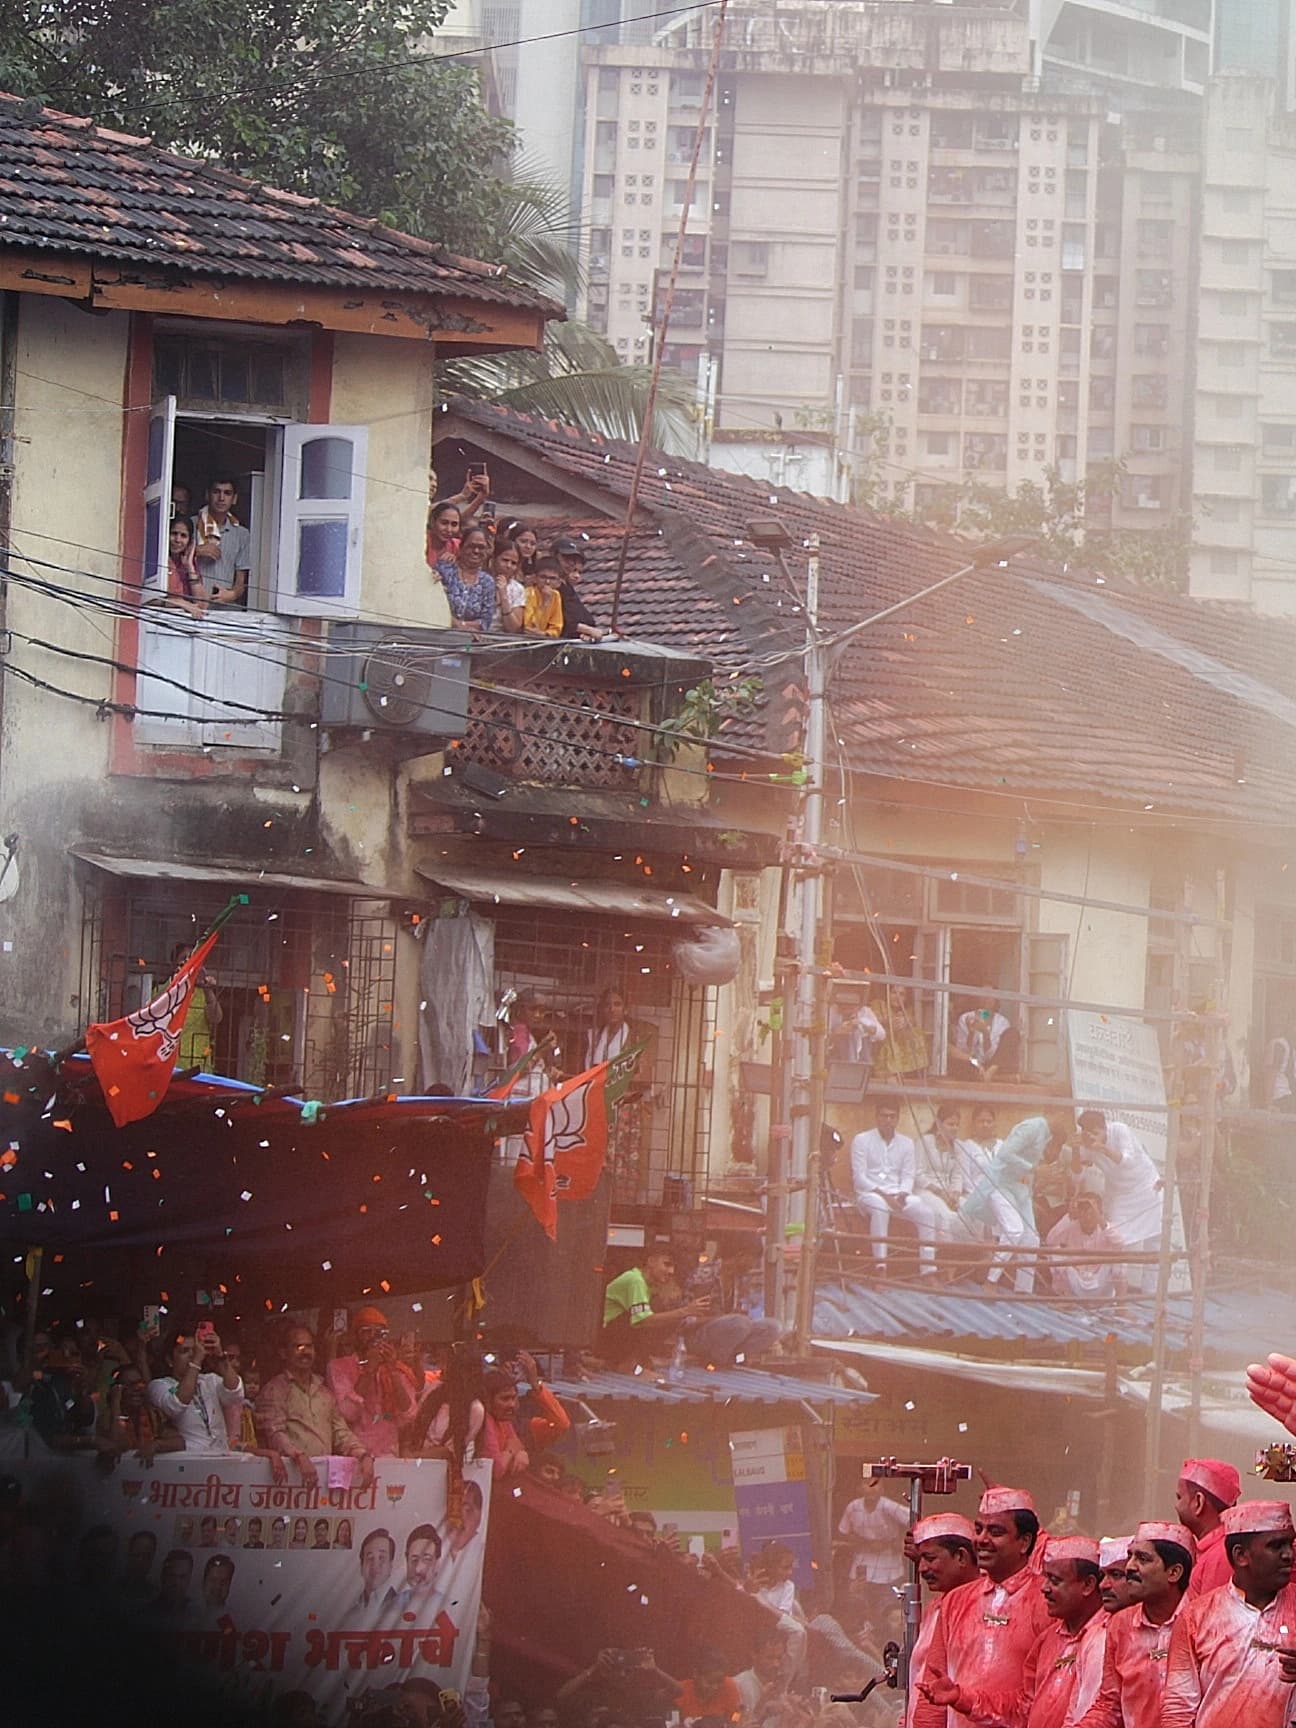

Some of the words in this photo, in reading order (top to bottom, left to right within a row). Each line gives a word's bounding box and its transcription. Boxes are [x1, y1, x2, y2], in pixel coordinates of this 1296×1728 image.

[149, 1474, 243, 1508] भारतीय
[249, 1483, 321, 1510] जनता
[176, 1614, 291, 1672] णेश
[304, 1610, 460, 1671] भक्तांचे
